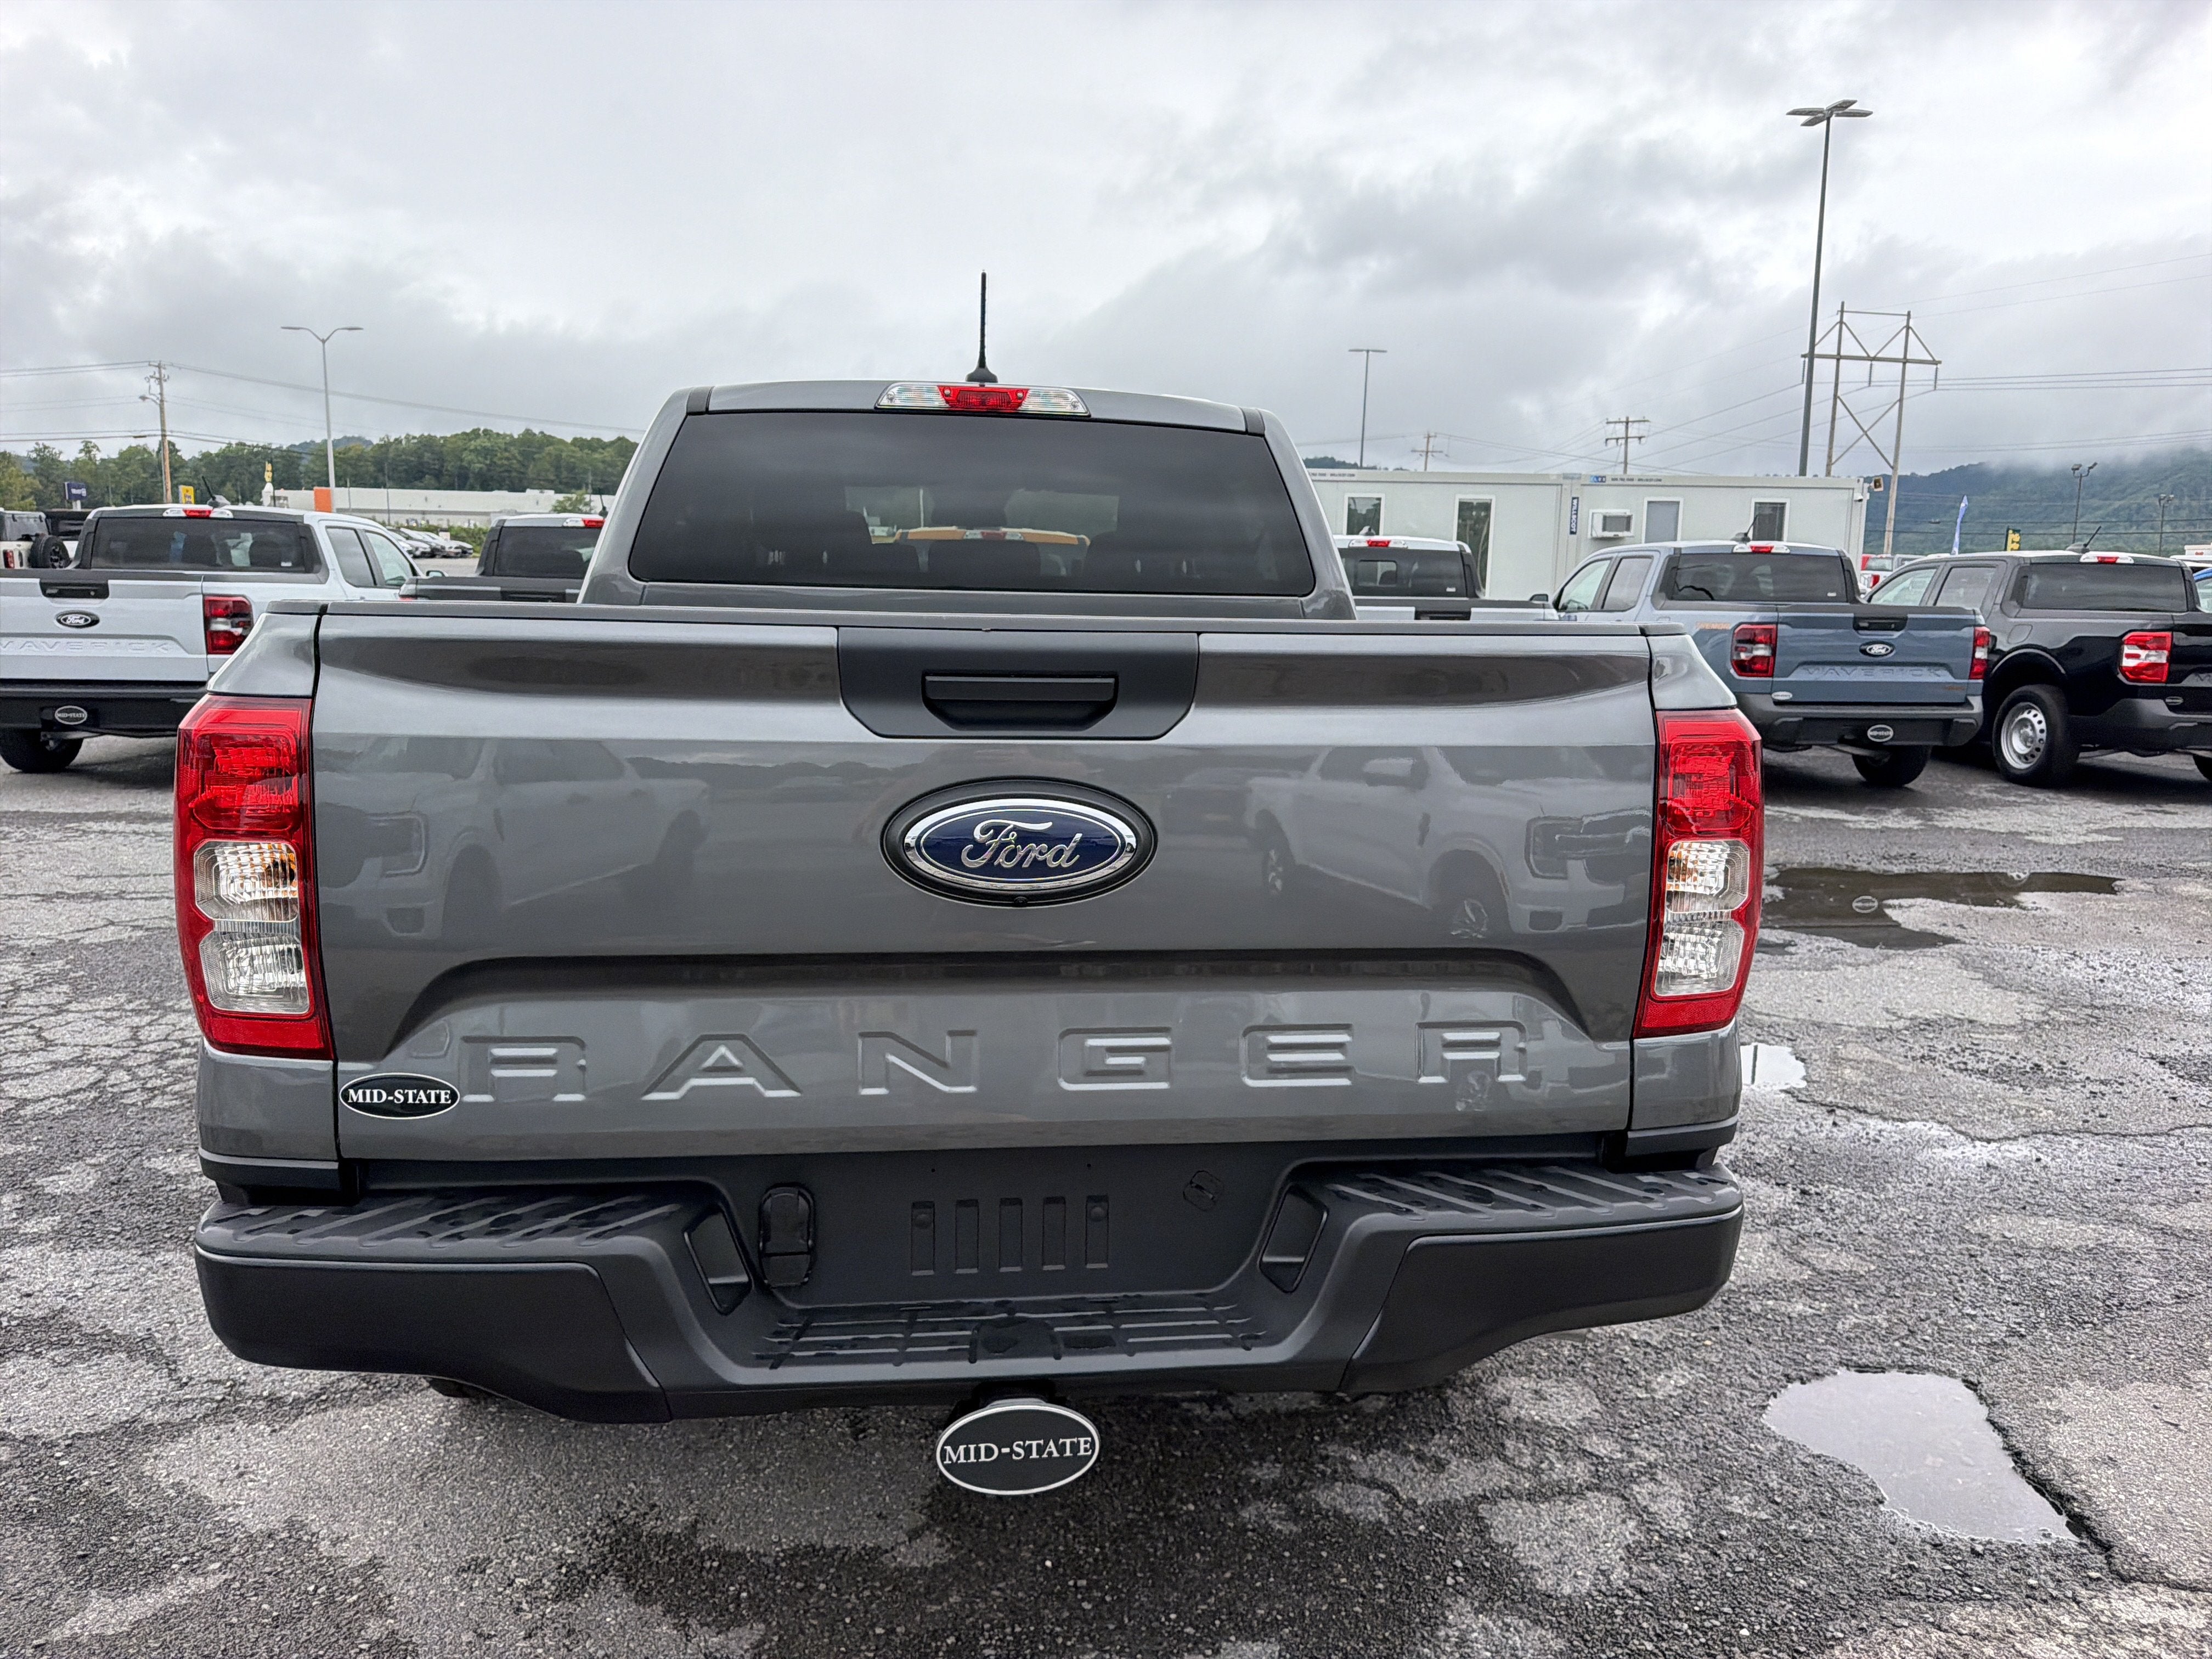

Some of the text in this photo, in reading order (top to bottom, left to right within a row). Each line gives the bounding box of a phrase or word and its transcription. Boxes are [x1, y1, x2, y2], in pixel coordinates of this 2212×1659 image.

[66, 614, 84, 624] Ford
[961, 819, 1081, 868] Ford
[462, 1020, 1527, 1103] RANGER
[347, 1088, 452, 1104] MID-STATE
[943, 1437, 1092, 1464] MID-STATE
